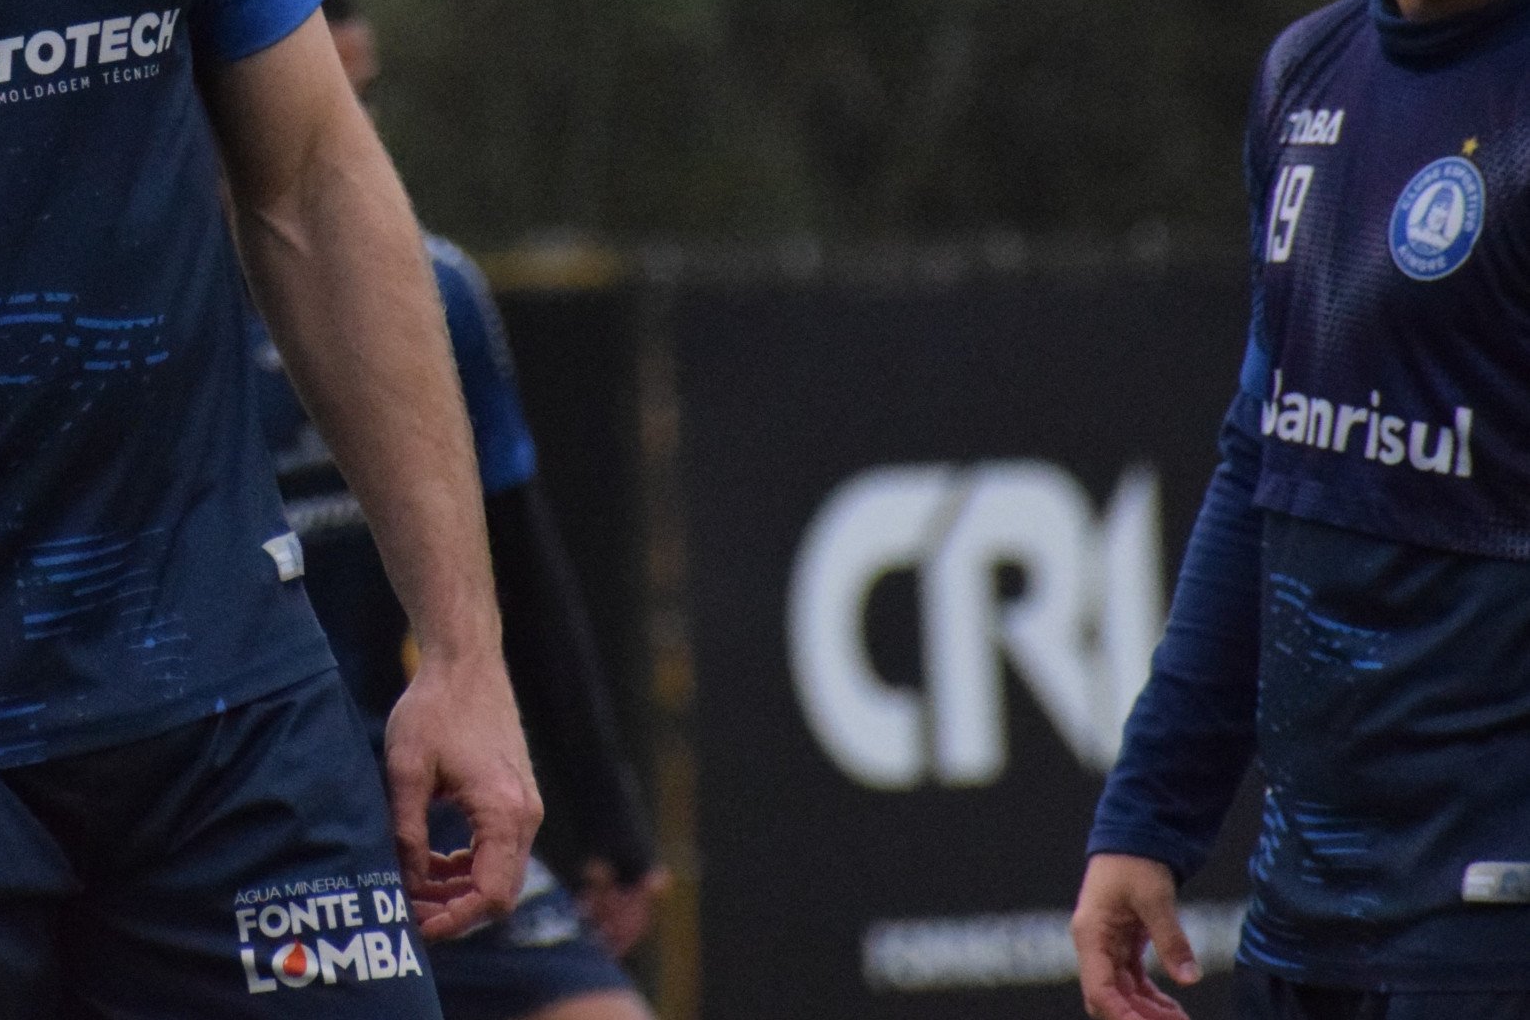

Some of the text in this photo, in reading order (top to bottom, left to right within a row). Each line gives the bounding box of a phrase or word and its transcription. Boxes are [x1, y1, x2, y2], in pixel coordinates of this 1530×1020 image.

[284, 876, 357, 897] MINERAL
[235, 888, 410, 944] FONTE DA
[240, 928, 423, 995] LOMBA
